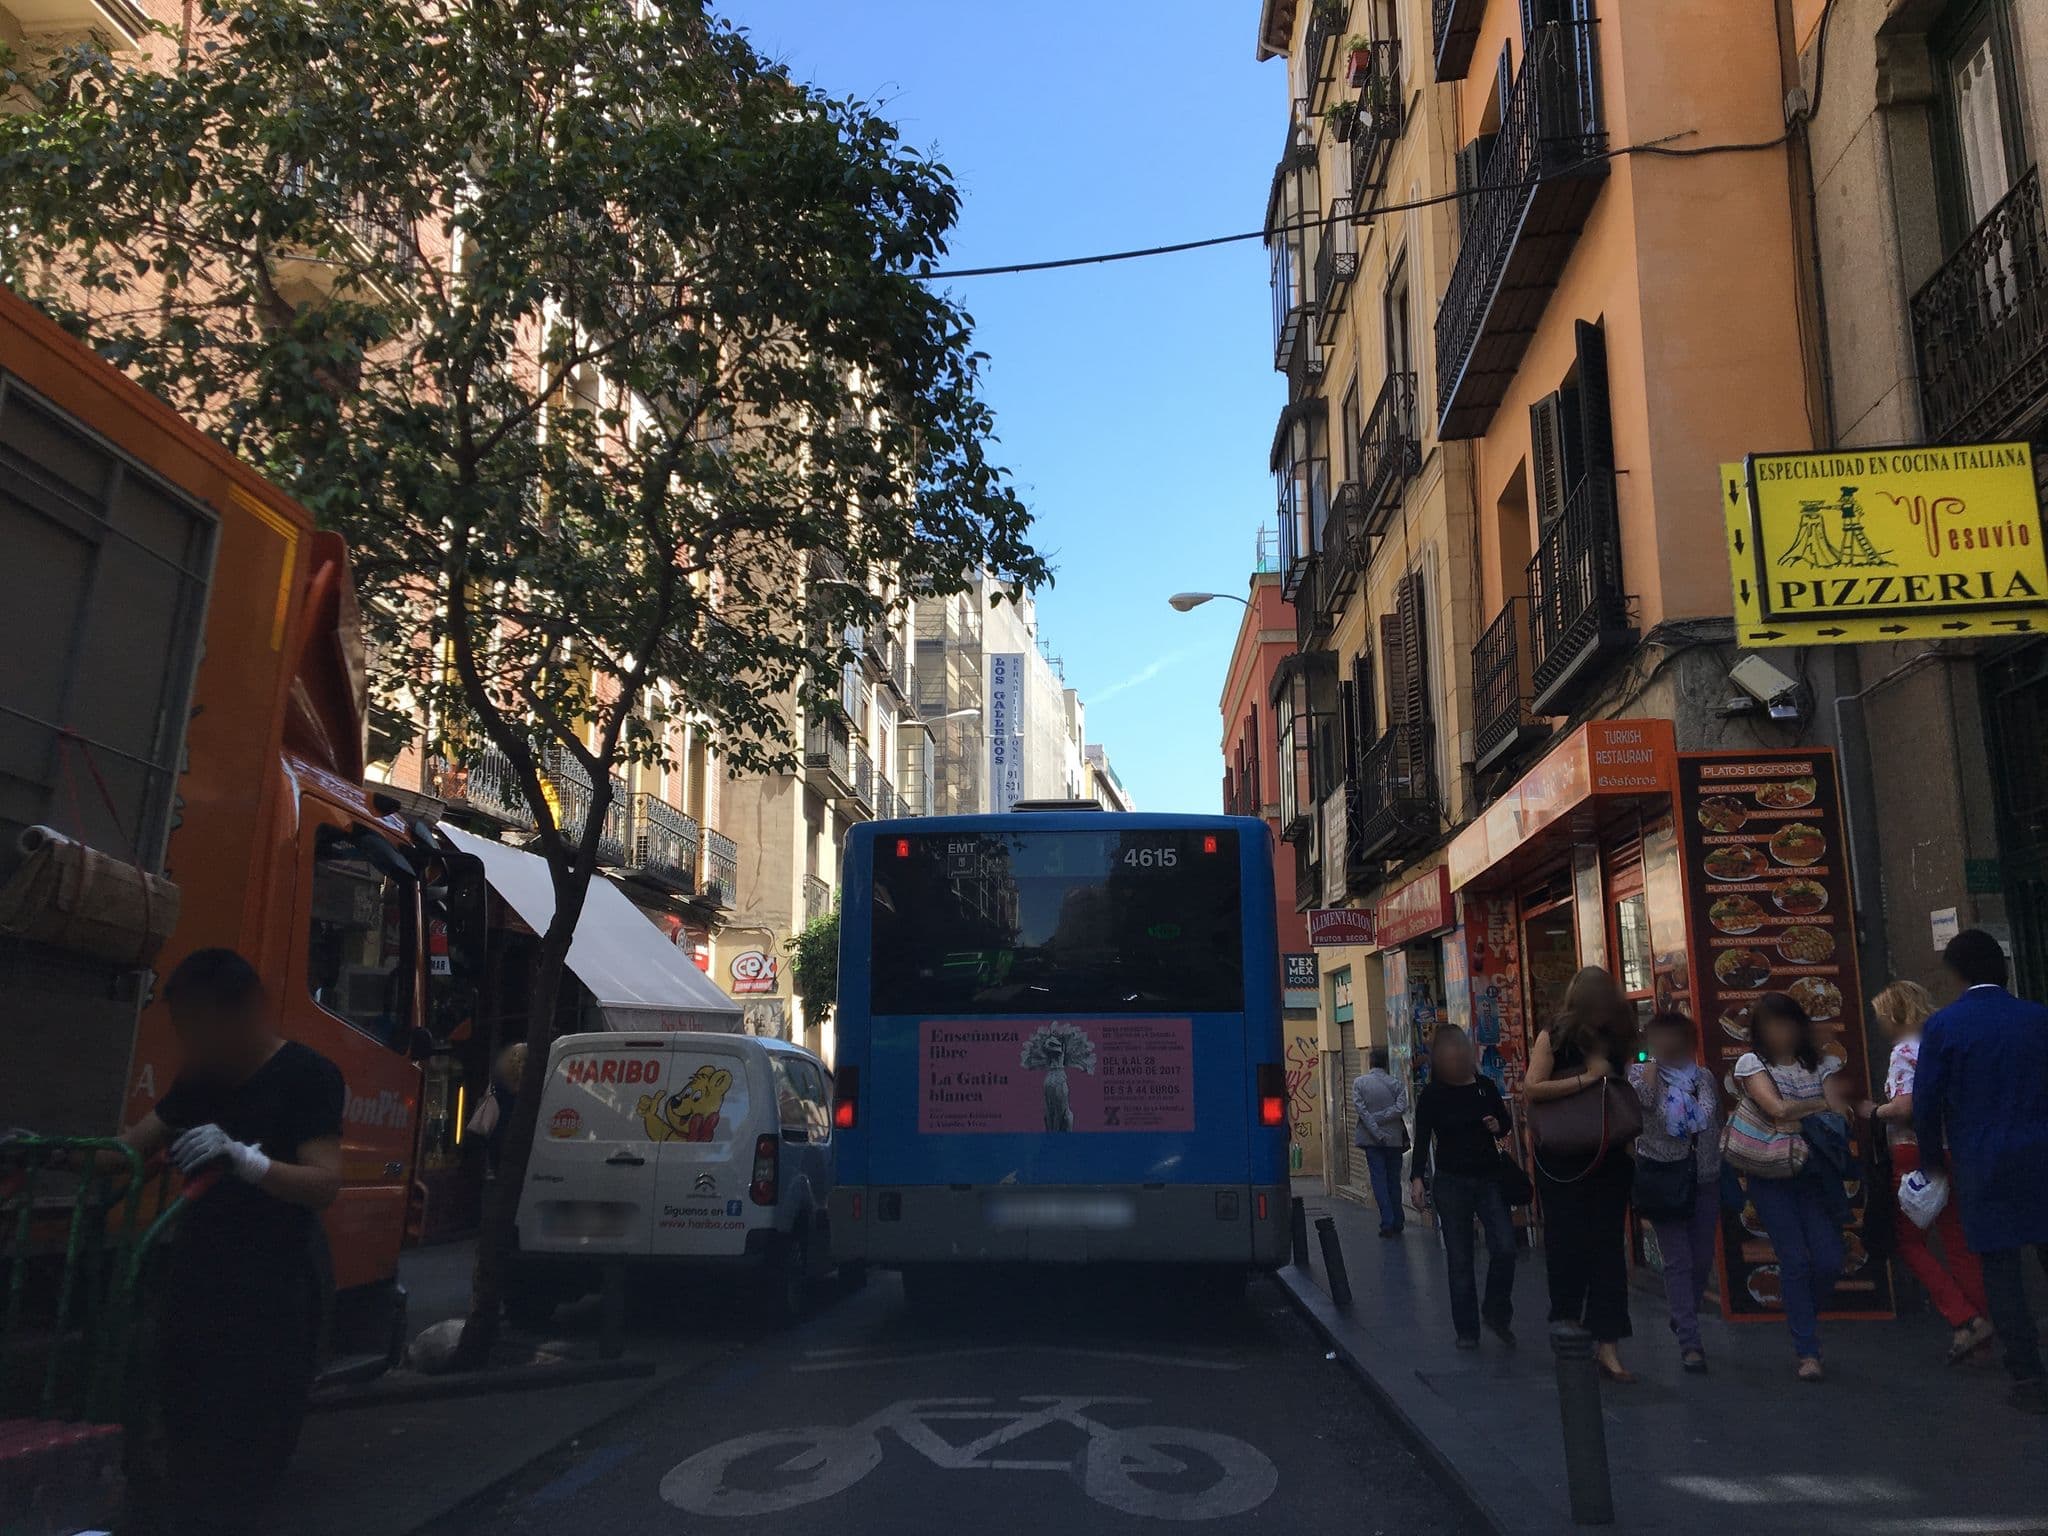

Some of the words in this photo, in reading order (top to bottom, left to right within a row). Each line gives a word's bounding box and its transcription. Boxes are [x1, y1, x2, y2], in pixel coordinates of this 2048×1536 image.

[1759, 457, 1865, 481] ESPECIALIDAD
[1869, 456, 1889, 475] EN
[1892, 452, 1949, 475] COCINA
[1953, 448, 2027, 472] ITALIANA
[1875, 490, 2030, 559] Vesuvio
[1777, 570, 2041, 609] PIZZERIA
[994, 657, 1005, 685] LOS
[993, 691, 1006, 765] GALLEGOS
[1603, 728, 1642, 746] TURKISH
[1595, 748, 1654, 766] RESTAURANT
[1703, 765, 1746, 777] PLATOS
[1748, 763, 1812, 775] BOSFOROS
[1005, 781, 1020, 792] 521
[1700, 785, 1721, 793] PLATO
[1008, 793, 1019, 802] 99
[1703, 836, 1729, 844] PLATO
[947, 842, 976, 854] EMT
[1123, 848, 1177, 868] 4615
[1768, 867, 1793, 876] PLATO
[1708, 884, 1732, 893] PLATO
[1770, 916, 1795, 925] PLATO
[1315, 935, 1342, 943] FRUTOS
[1346, 934, 1369, 942] SECOS
[1288, 957, 1313, 967] TEX
[1288, 966, 1314, 976] MEX
[1289, 976, 1315, 984] FOOD
[930, 1028, 1019, 1043] Enseñanza
[929, 1045, 968, 1059] libre
[1102, 1056, 1120, 1066] DEL
[1130, 1056, 1142, 1065] AL
[566, 1059, 661, 1085] HARIBO
[1102, 1066, 1115, 1076] DE
[1117, 1066, 1143, 1076] MAYO
[1145, 1066, 1157, 1076] DE
[1159, 1065, 1182, 1075] 2017
[931, 1071, 952, 1086] La
[929, 1088, 983, 1103] blanca
[1103, 1085, 1116, 1096] DE
[711, 1207, 724, 1216] en
